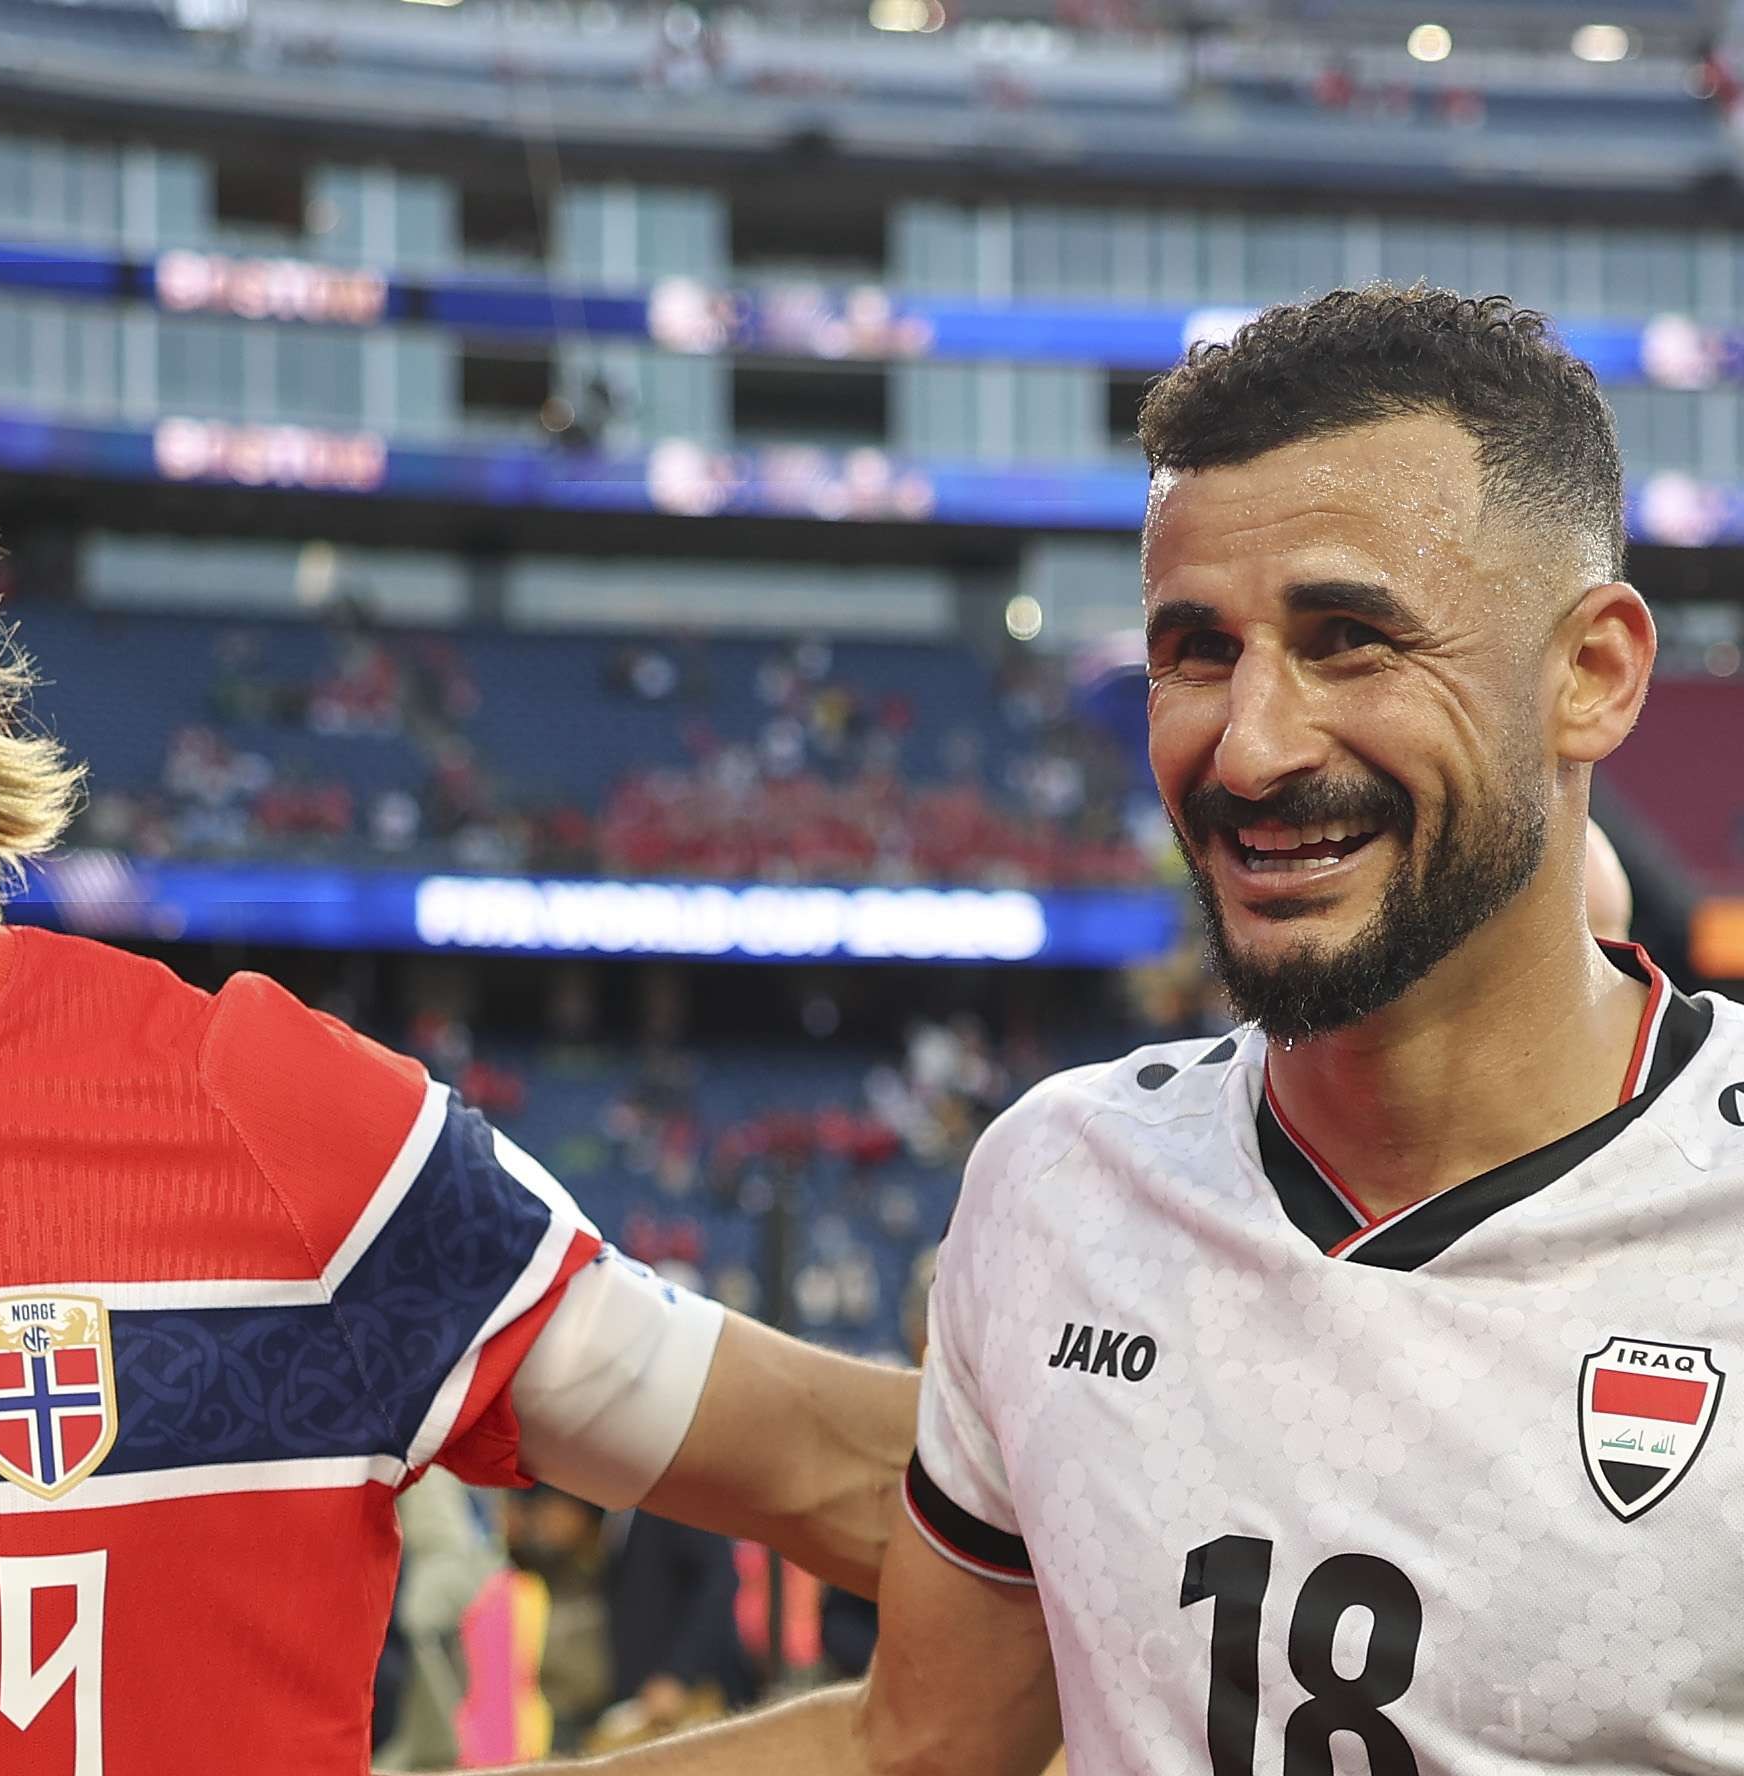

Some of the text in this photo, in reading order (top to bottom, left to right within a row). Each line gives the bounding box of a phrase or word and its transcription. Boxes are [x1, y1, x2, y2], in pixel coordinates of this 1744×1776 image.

[12, 1303, 56, 1321] NORGE
[1048, 1322, 1156, 1382] JAKO
[1617, 1348, 1695, 1373] IRAQ
